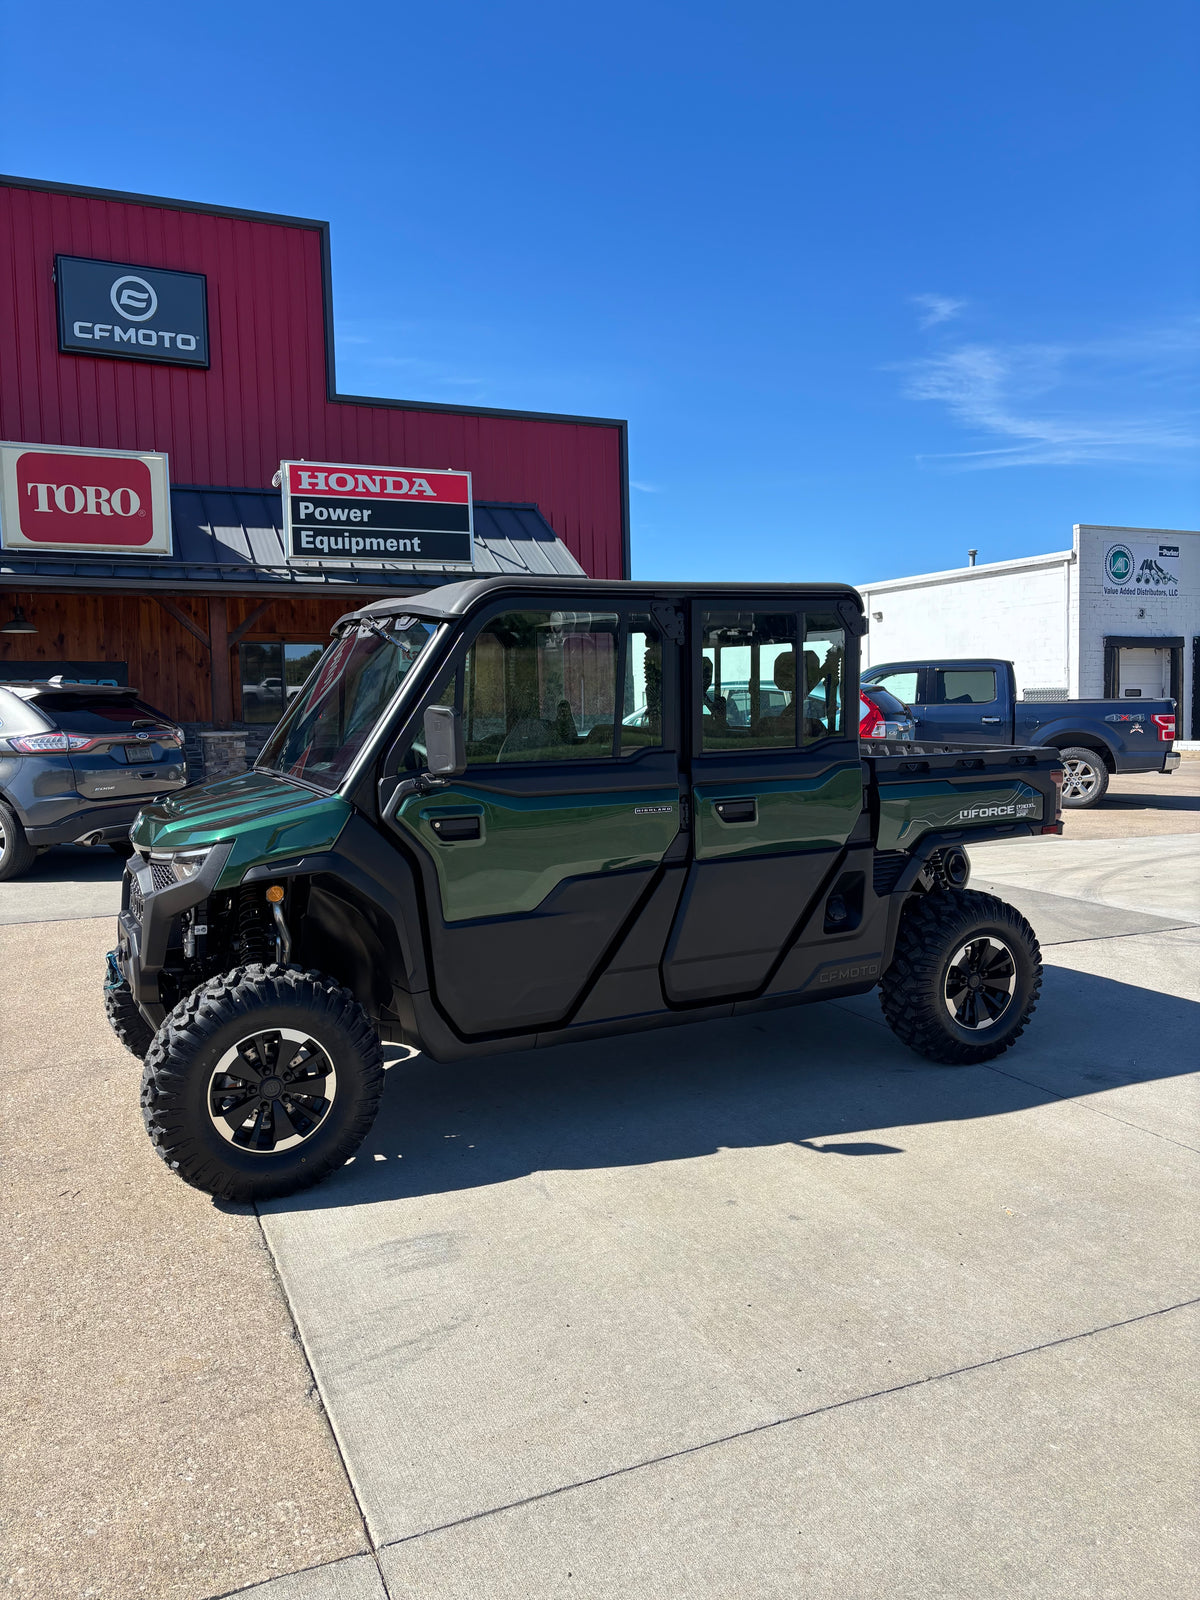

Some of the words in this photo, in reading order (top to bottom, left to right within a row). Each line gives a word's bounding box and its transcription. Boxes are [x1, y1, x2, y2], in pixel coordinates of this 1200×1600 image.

[73, 321, 197, 351] CFMOTO
[297, 471, 437, 496] HONDA
[27, 482, 141, 517] TORO
[299, 501, 372, 522] Power
[300, 530, 421, 554] Equipment
[1104, 587, 1119, 595] Value
[1120, 587, 1136, 596] Added
[1136, 588, 1168, 597] Distributors,
[1168, 589, 1178, 597] LLC
[1139, 609, 1144, 617] 3
[820, 964, 878, 983] CFMOTO
